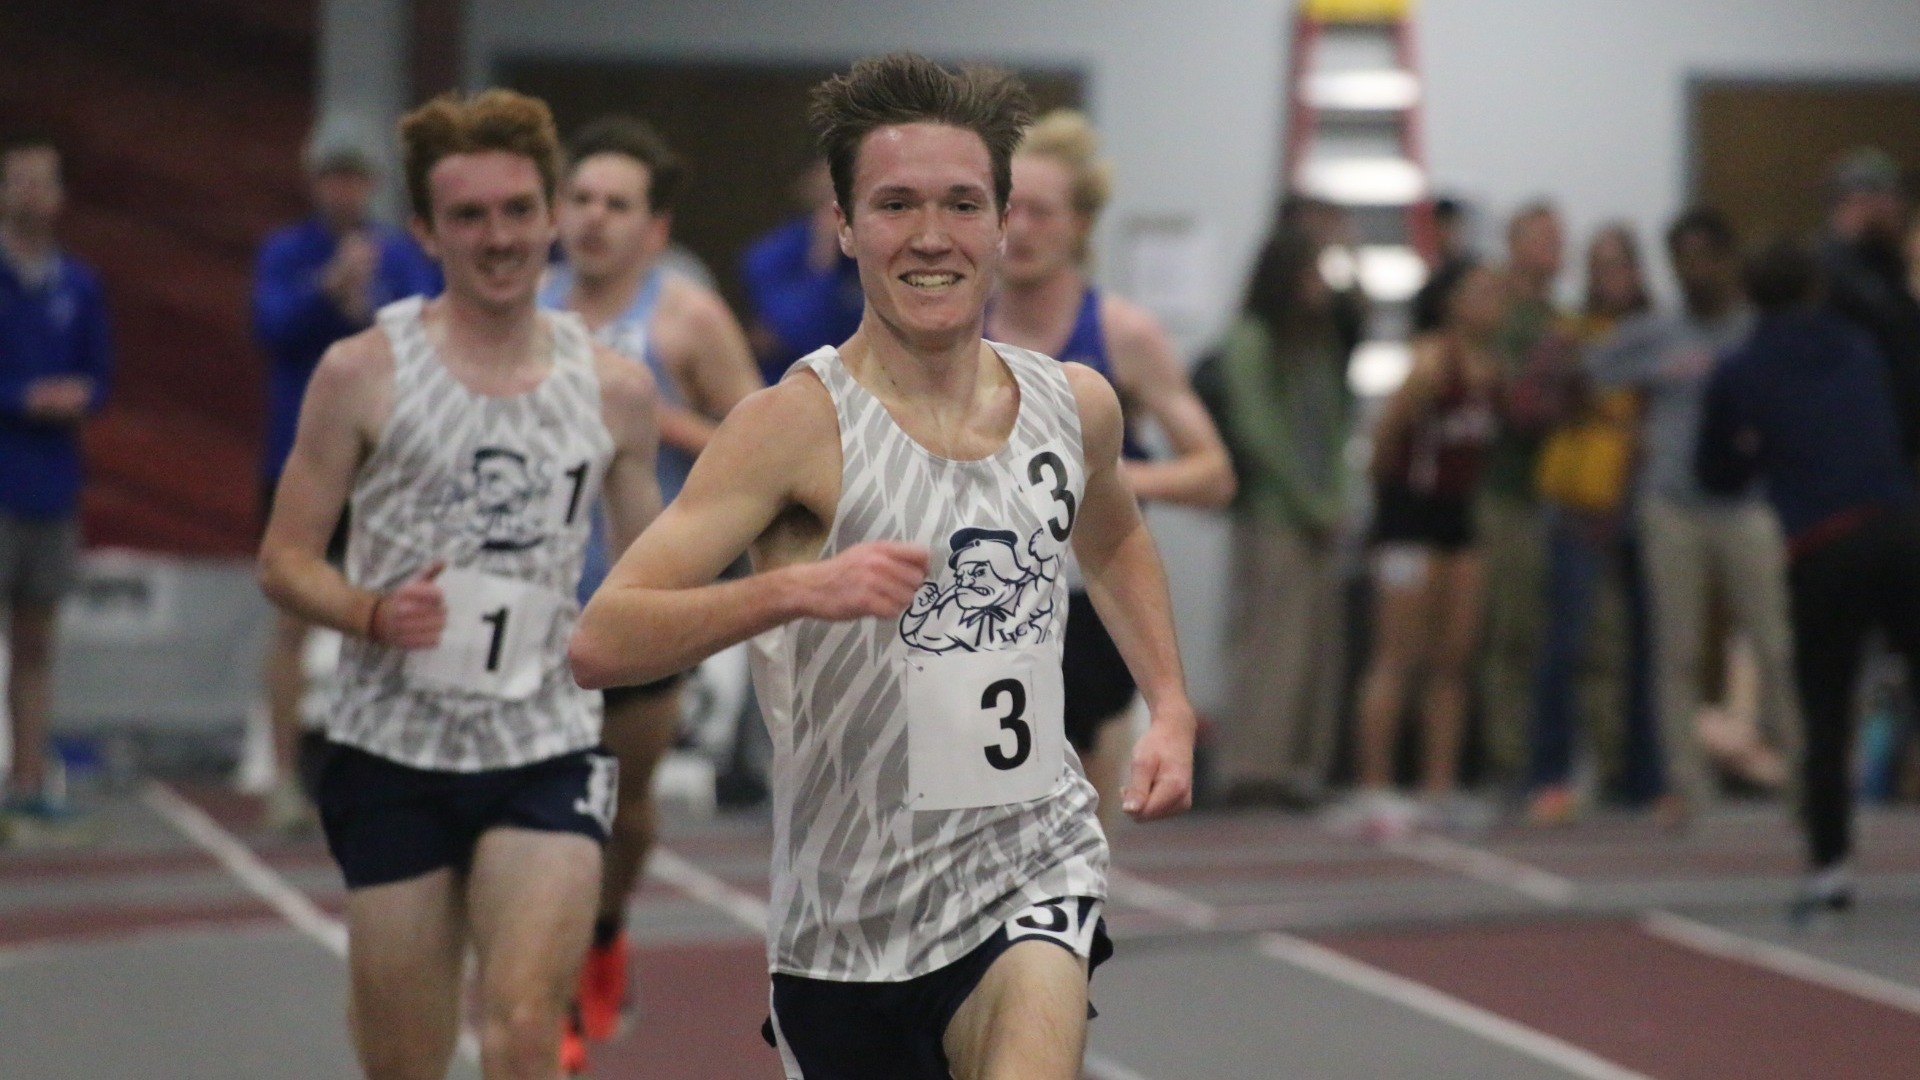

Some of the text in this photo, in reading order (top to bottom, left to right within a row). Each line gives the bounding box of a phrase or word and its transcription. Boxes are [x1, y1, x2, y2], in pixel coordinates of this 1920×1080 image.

[565, 463, 588, 525] 1
[1029, 451, 1076, 543] 3
[483, 608, 507, 673] 1
[980, 678, 1032, 771] 3
